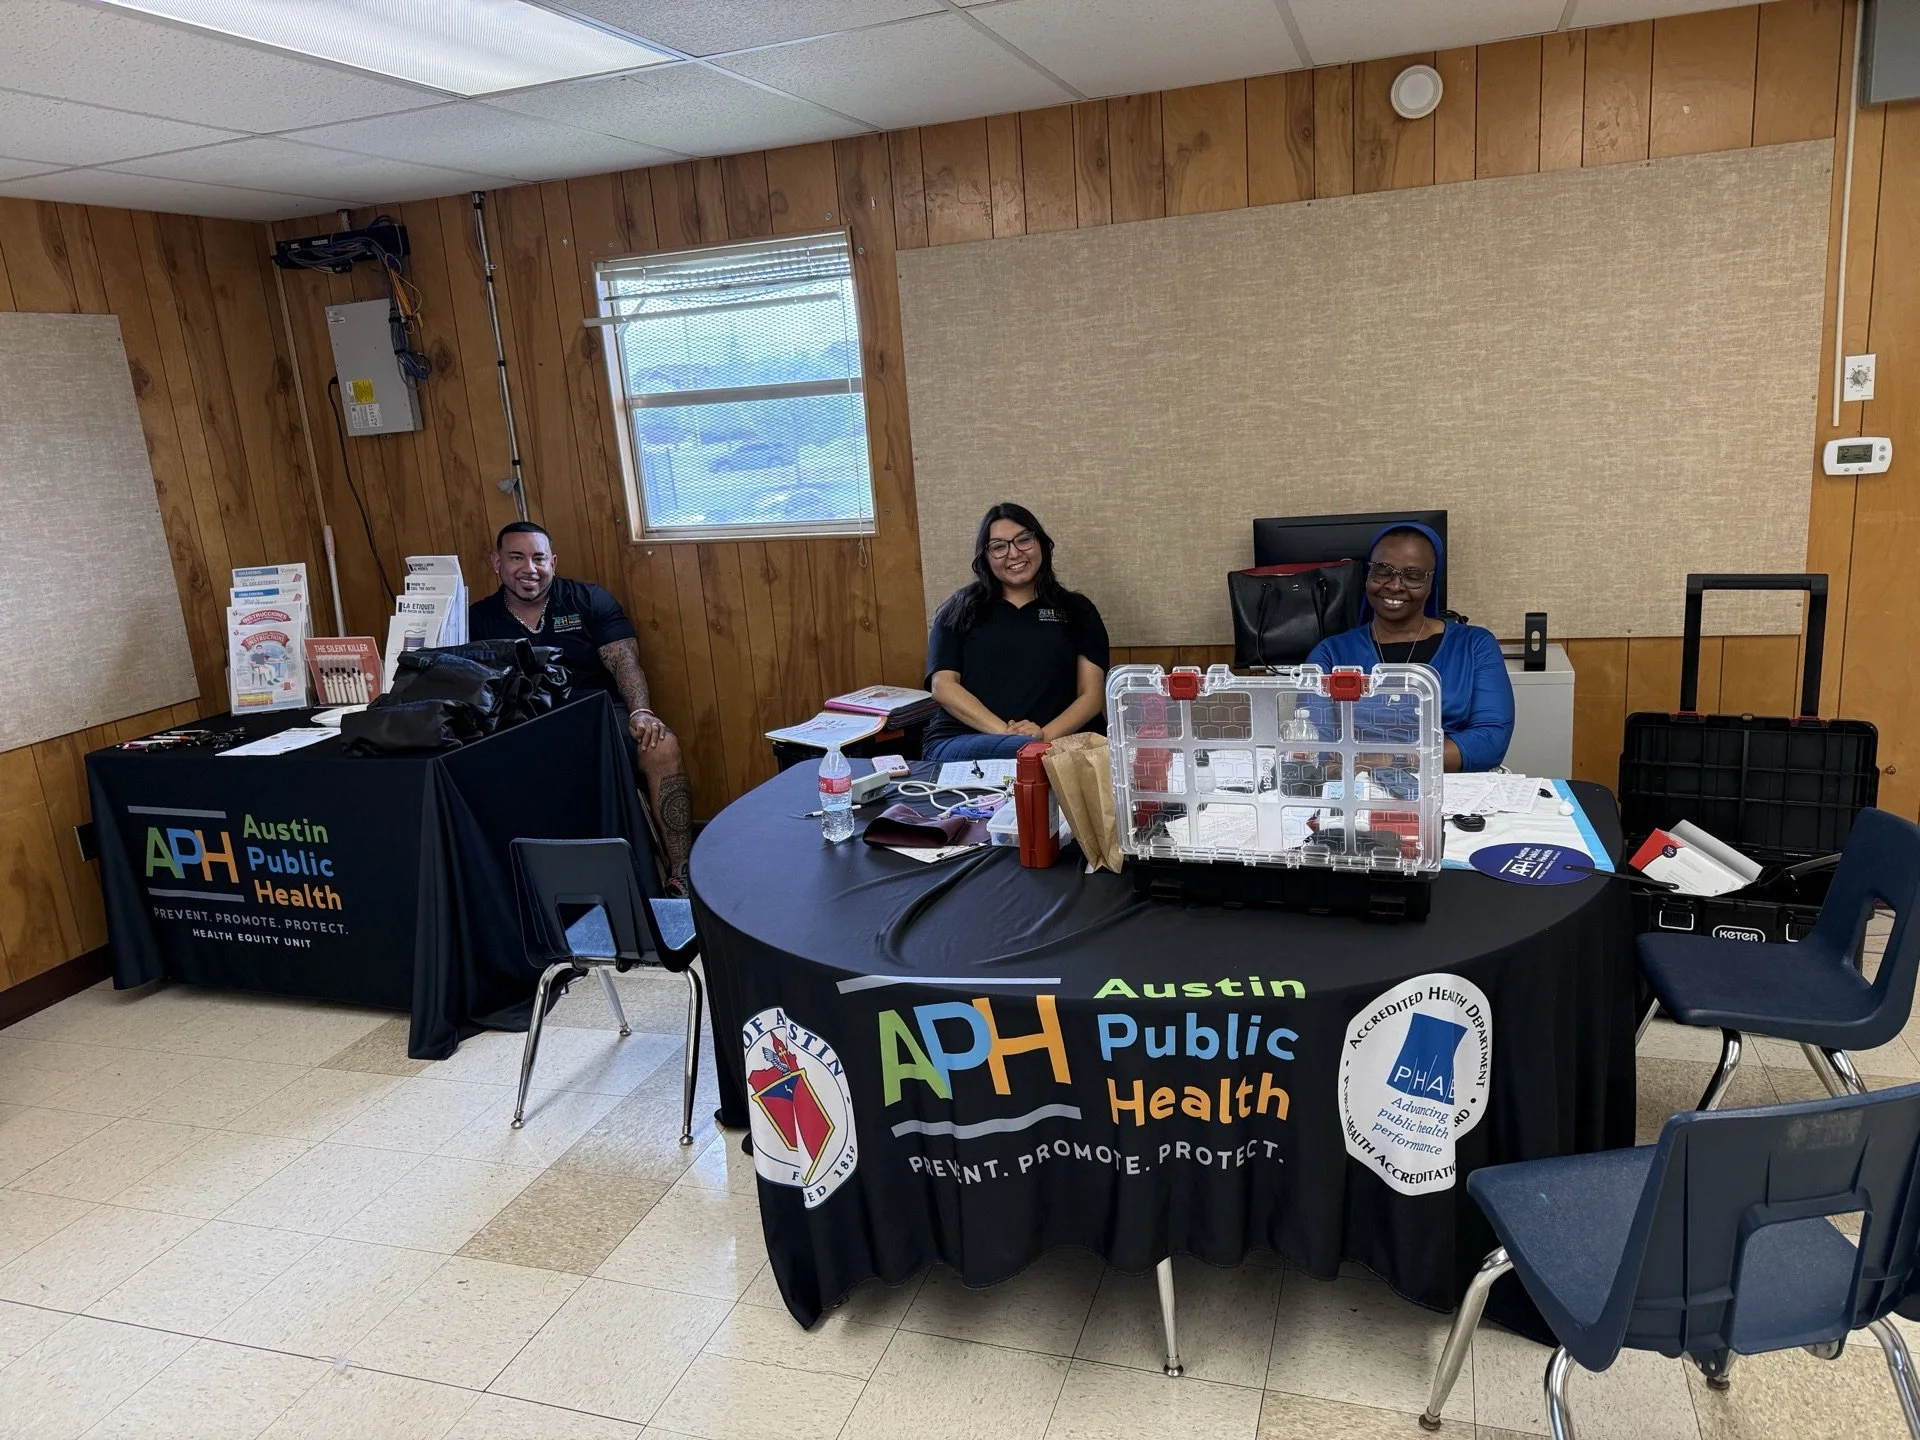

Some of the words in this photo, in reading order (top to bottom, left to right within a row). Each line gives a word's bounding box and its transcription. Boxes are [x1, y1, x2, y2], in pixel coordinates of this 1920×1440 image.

[314, 644, 326, 653] THE
[326, 644, 347, 653] SILENT
[347, 643, 369, 652] KILLER
[242, 814, 329, 844] Austin
[145, 826, 239, 884] APH
[246, 846, 335, 878] Public
[254, 879, 344, 911] Health
[153, 907, 212, 922] PREVENT.
[215, 912, 281, 928] PROMOTE.
[285, 919, 349, 935] PROTECT.
[193, 928, 233, 941] HEALTH
[238, 933, 279, 945] EQUITY
[284, 937, 311, 949] UNIT
[1093, 976, 1306, 1000] Austin
[776, 1009, 844, 1077] ASTIN
[878, 994, 1072, 1107] APH
[1097, 1012, 1300, 1063] Public
[1349, 991, 1423, 1050] ACCREDITED
[1428, 986, 1468, 1007] HEALTH
[1465, 1003, 1491, 1088] DEPARTMENT
[1107, 1072, 1290, 1127] Health
[1392, 1097, 1449, 1124] Advancing
[1347, 1115, 1376, 1154] HEALTH
[1372, 1121, 1442, 1155] performance
[1377, 1108, 1416, 1131] public
[1417, 1121, 1448, 1139] health
[834, 1146, 855, 1178] 1839
[908, 1156, 1009, 1185] PREVNT.
[1159, 1139, 1284, 1171] PROTECT.
